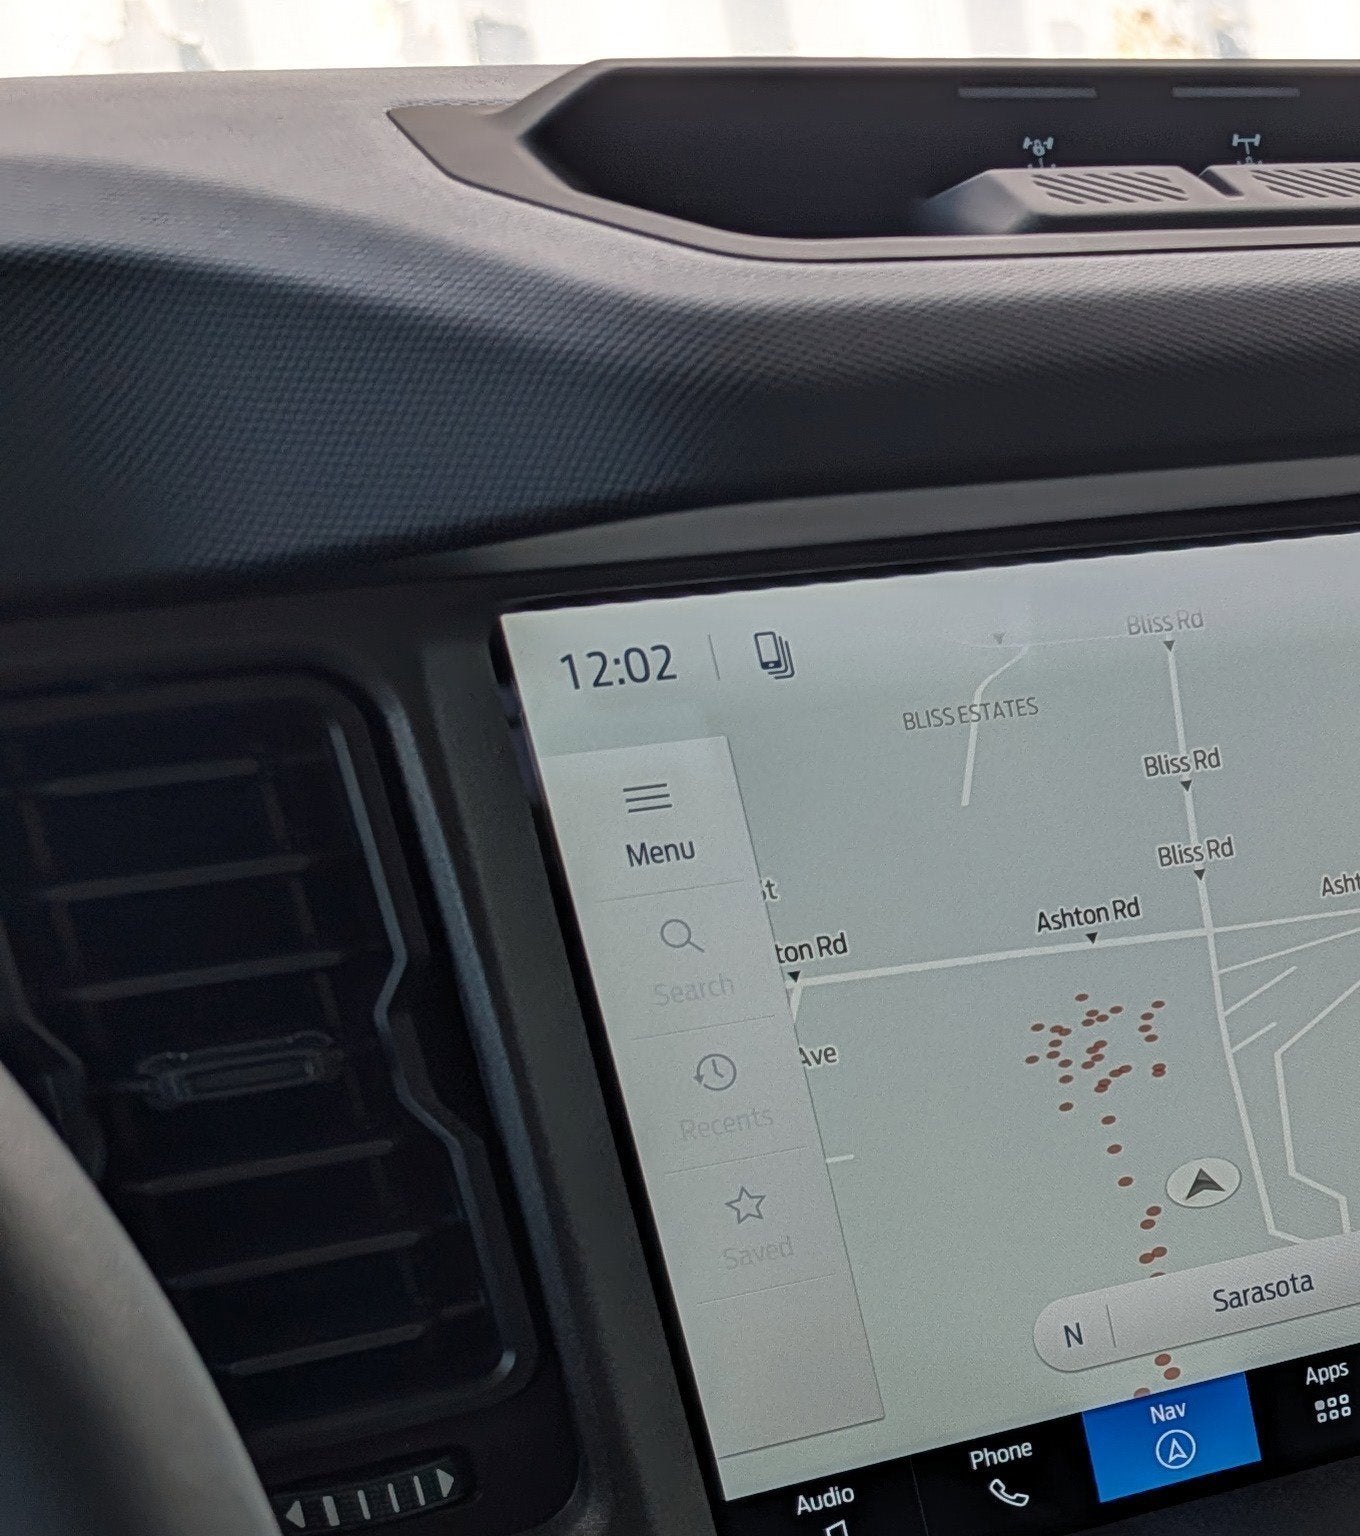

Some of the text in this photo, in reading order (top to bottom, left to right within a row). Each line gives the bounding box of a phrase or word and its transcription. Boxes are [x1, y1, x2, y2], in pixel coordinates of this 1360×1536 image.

[1126, 608, 1204, 637] Bliss Rd
[558, 644, 677, 691] 12:02
[903, 697, 1039, 732] BLISS ESTATES
[1143, 747, 1221, 778] Bliss Rd
[626, 838, 696, 869] Menu
[1158, 836, 1234, 868] Bliss Rd
[1036, 897, 1141, 934] Ashton Rd
[816, 932, 847, 957] Rd
[654, 974, 735, 1006] Search
[679, 1107, 774, 1141] Recents
[722, 1237, 794, 1271] Saved
[1063, 1270, 1315, 1348] N Sarasota
[1305, 1359, 1349, 1387] Apps
[1150, 1400, 1187, 1424] Nav
[969, 1439, 1033, 1471] Phone
[796, 1485, 855, 1515] Audio
